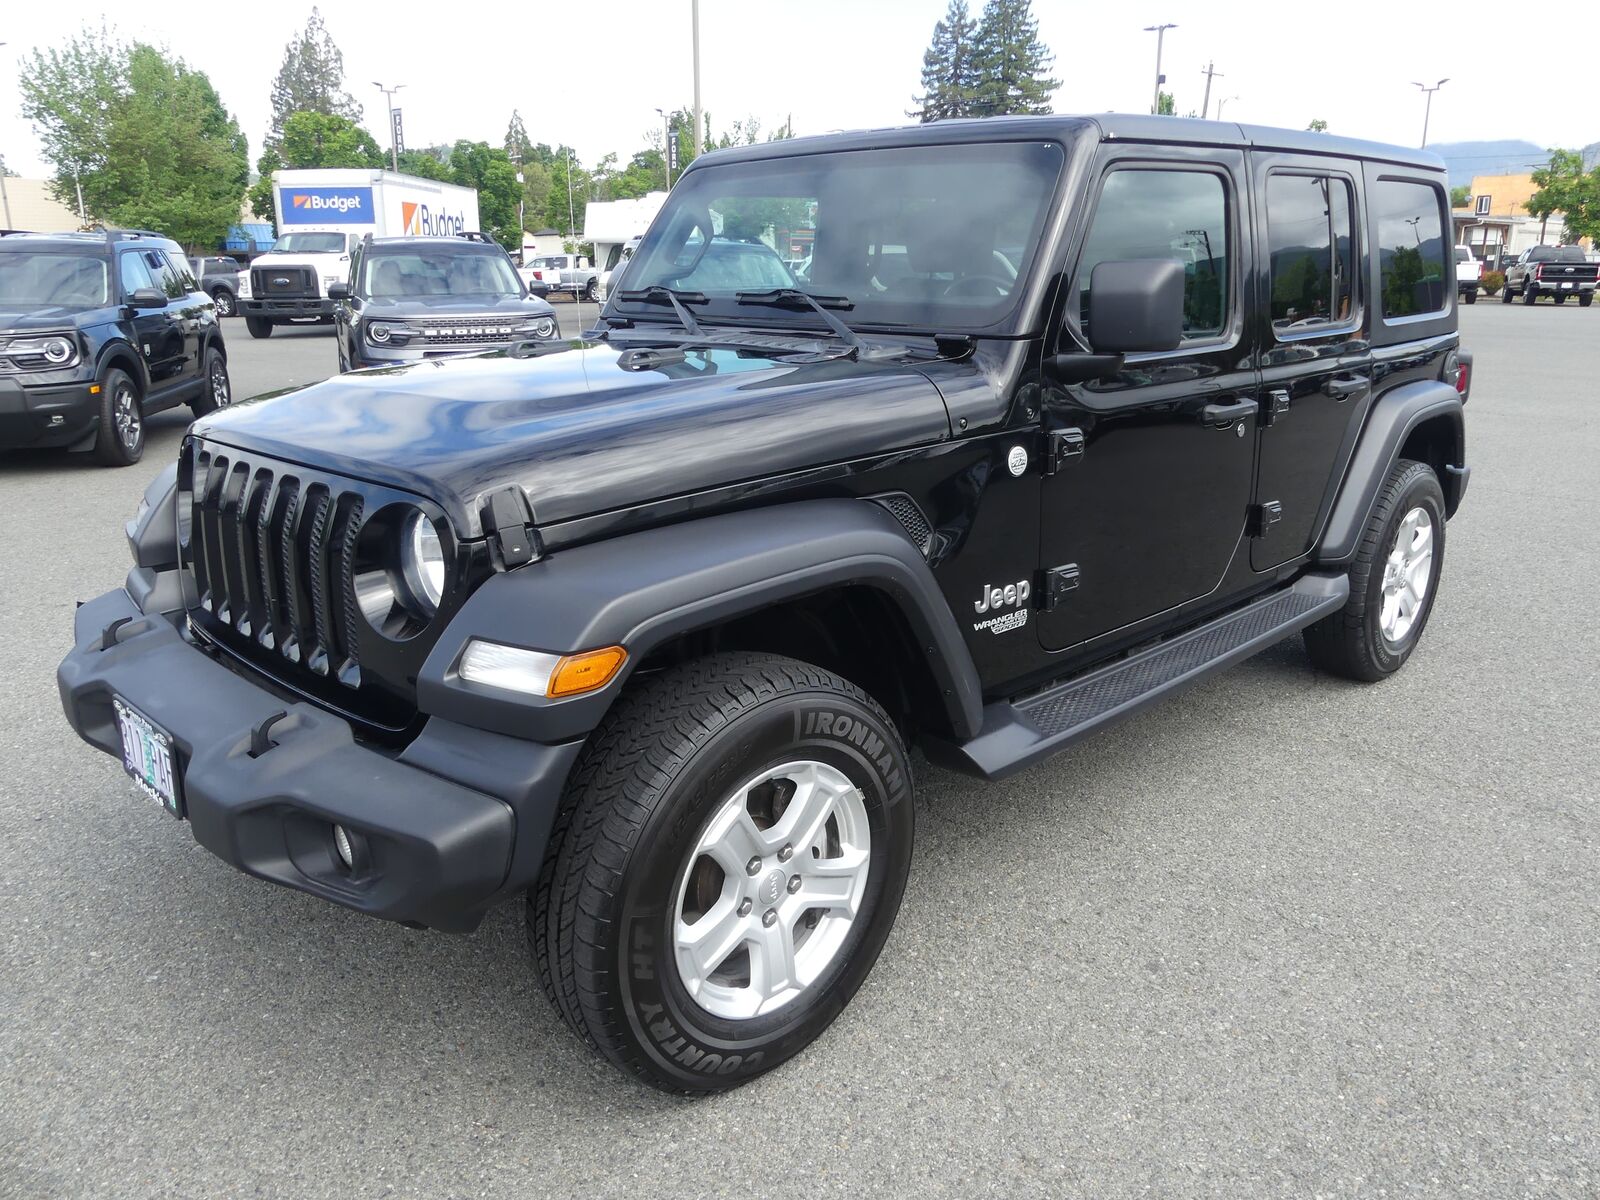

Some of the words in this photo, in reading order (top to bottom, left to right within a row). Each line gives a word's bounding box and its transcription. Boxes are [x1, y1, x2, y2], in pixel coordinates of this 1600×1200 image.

[395, 115, 403, 153] FORD
[312, 196, 361, 213] Budget
[421, 204, 465, 237] Budget
[424, 328, 512, 336] BRONCO
[974, 580, 1030, 613] Jeep
[973, 608, 1028, 631] WRANGLER
[804, 711, 903, 794] IRONMAN
[632, 925, 654, 980] HT
[639, 1002, 765, 1075] COUNTRY
